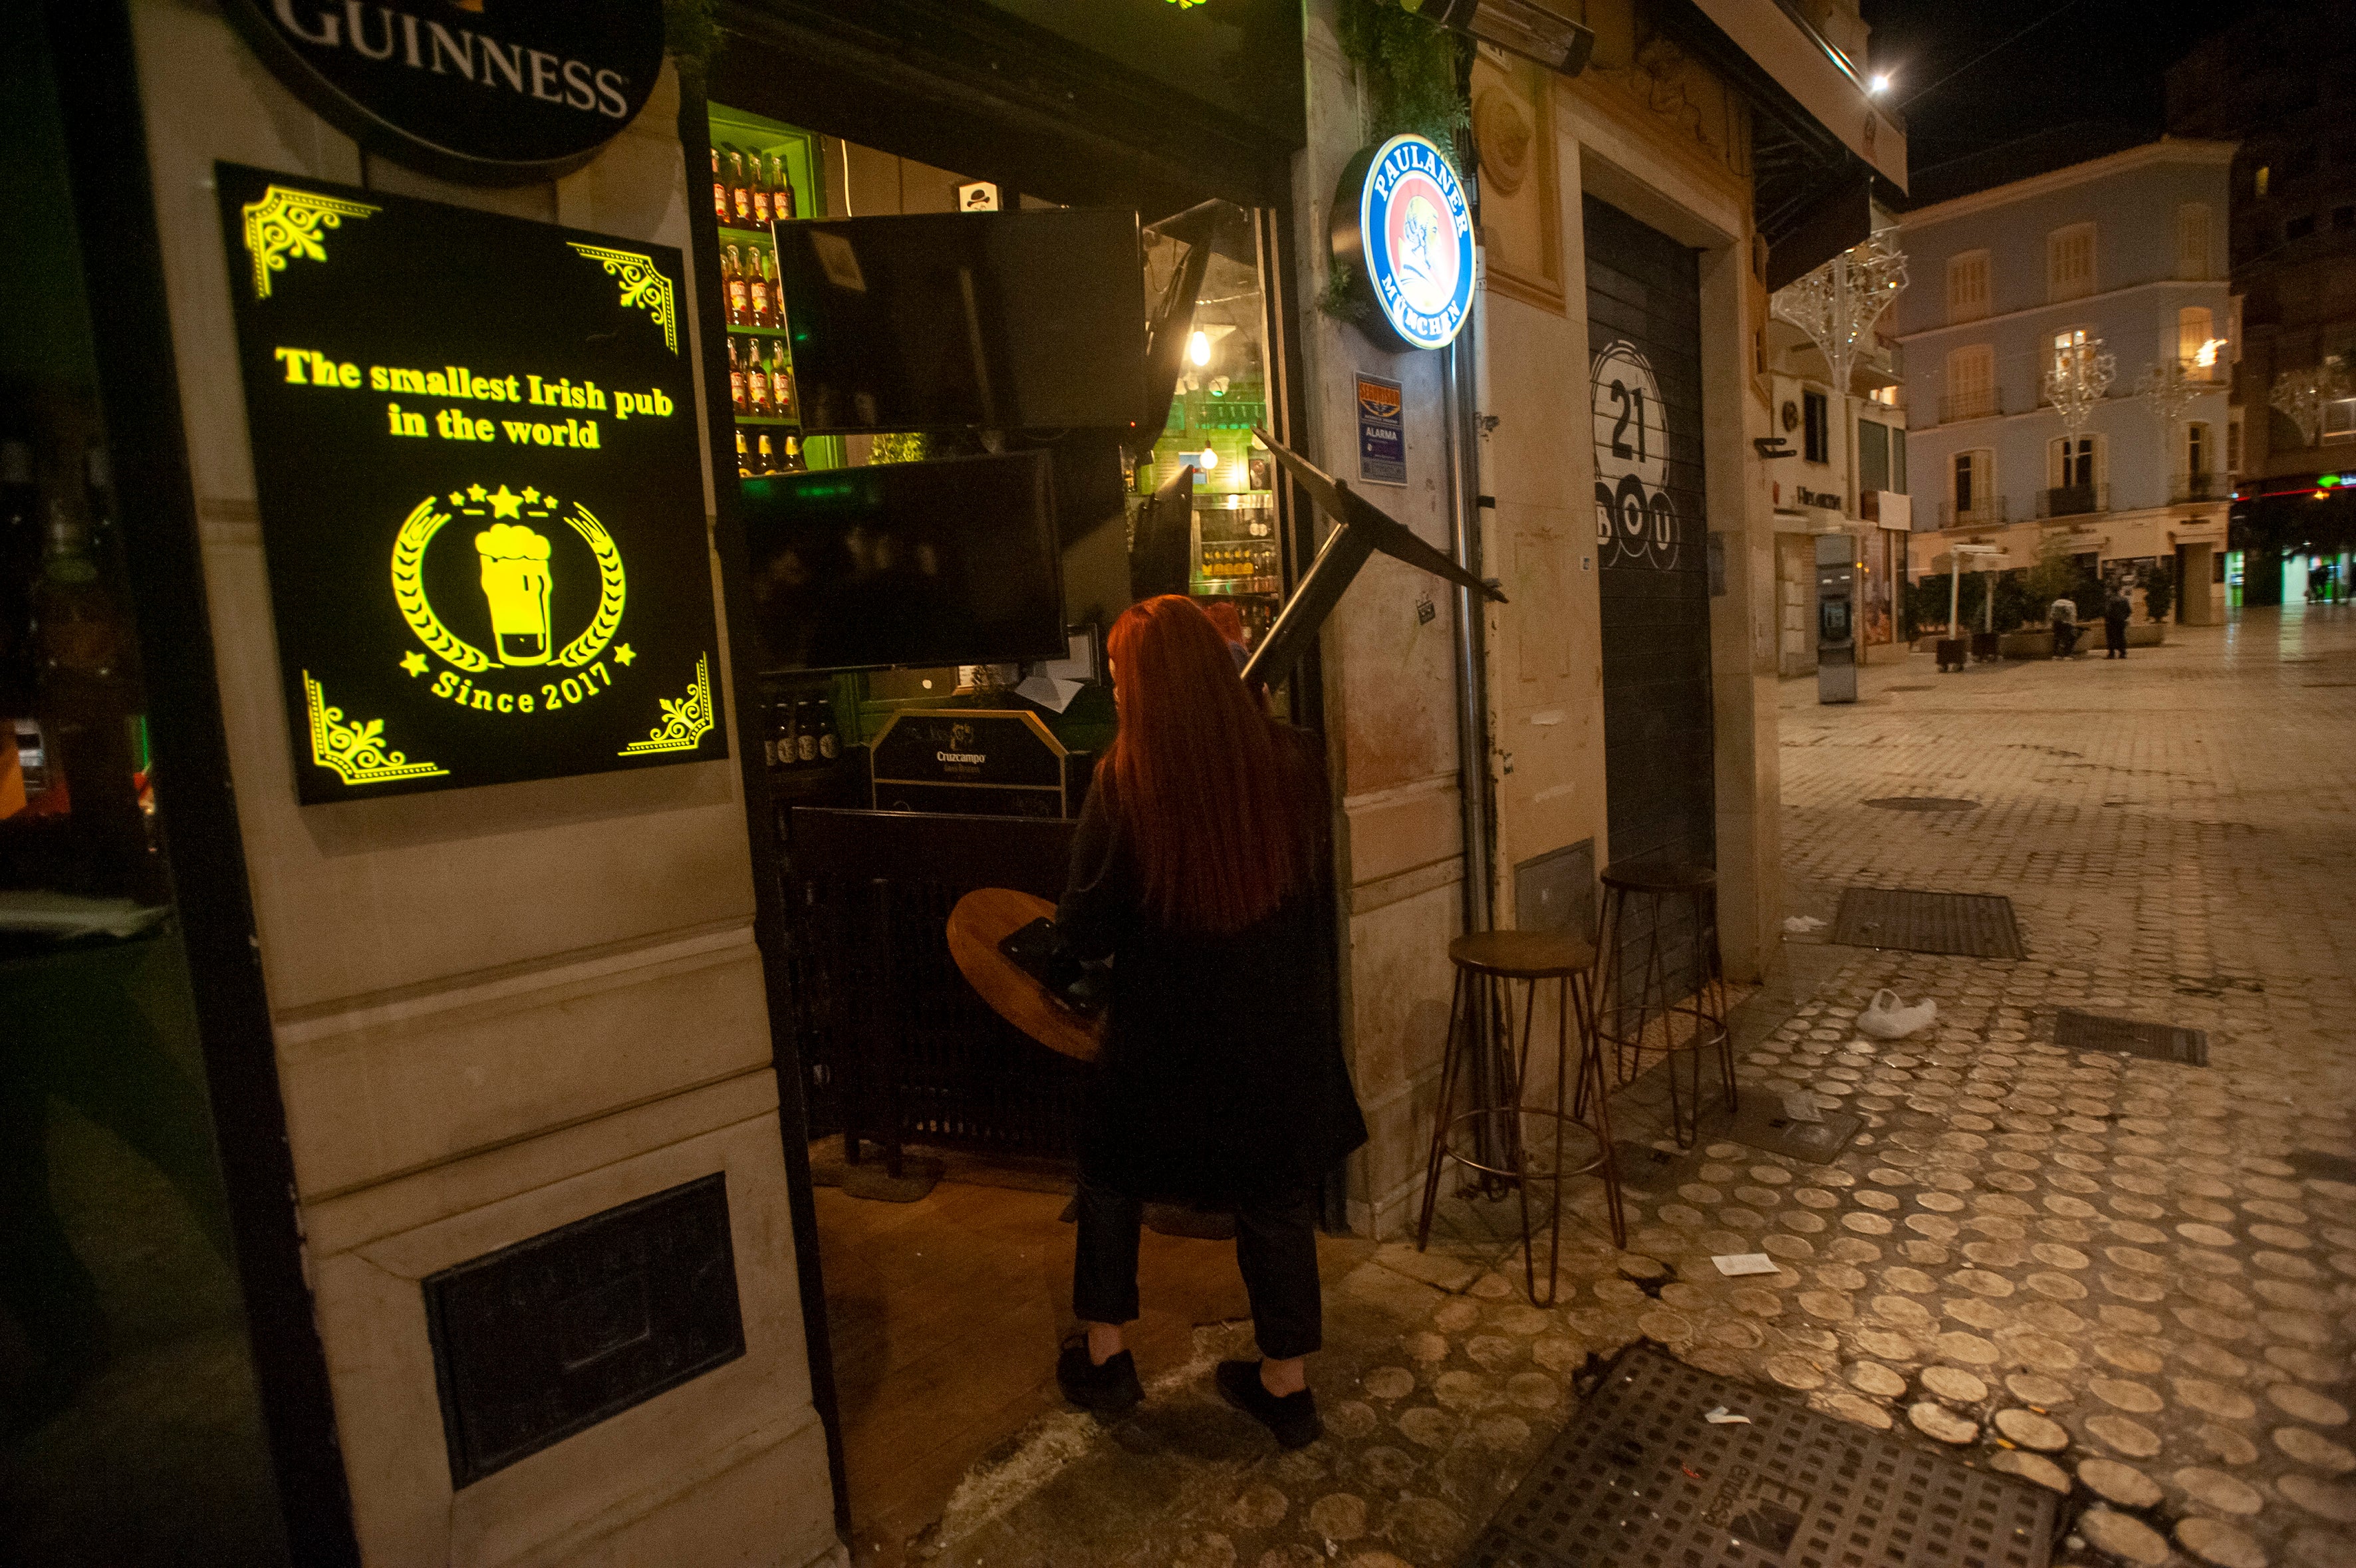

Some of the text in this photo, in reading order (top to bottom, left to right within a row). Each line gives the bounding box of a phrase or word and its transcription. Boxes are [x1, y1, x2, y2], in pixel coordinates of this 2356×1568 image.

[1374, 145, 1469, 238] PAULANER
[1381, 273, 1461, 336] MÜNCHEN
[275, 346, 674, 420] The smallest Irish pub
[388, 403, 601, 450] in the world
[1366, 426, 1398, 442] ALARMA
[1610, 378, 1646, 463] 21
[430, 661, 612, 714] Since 2017
[936, 751, 987, 765] Cruzcampo
